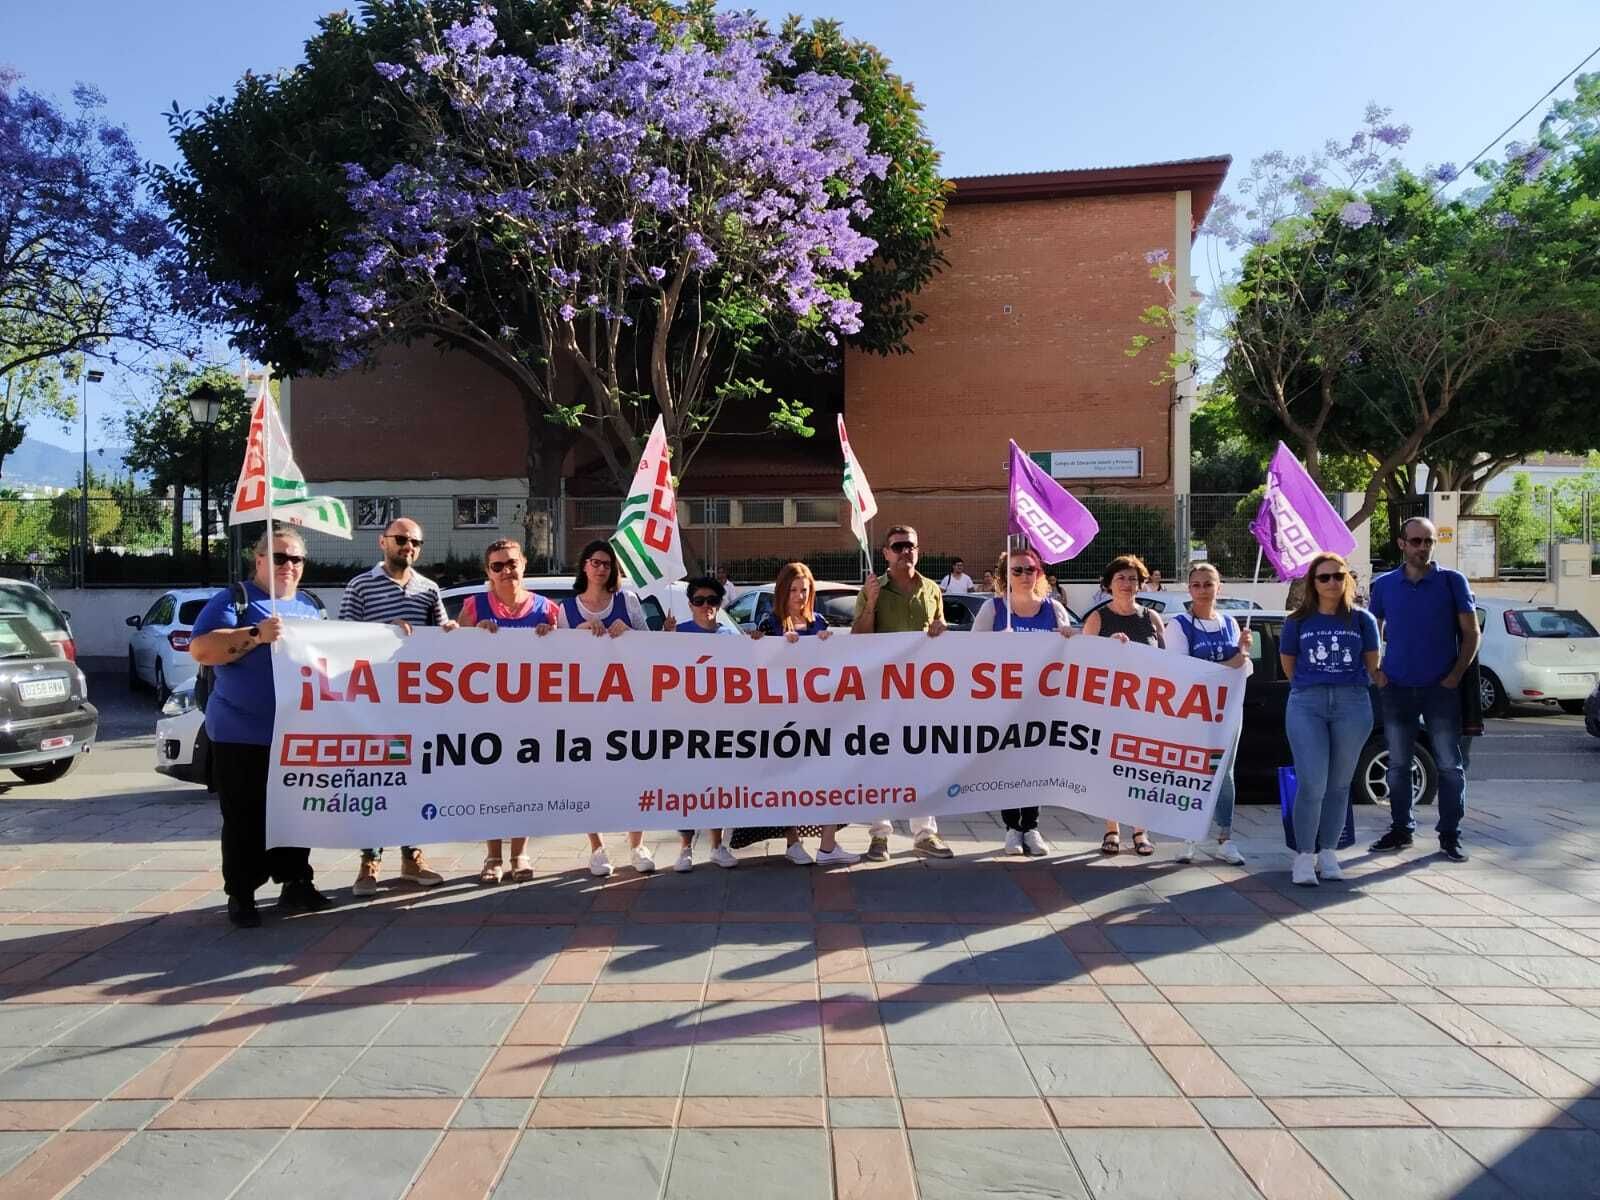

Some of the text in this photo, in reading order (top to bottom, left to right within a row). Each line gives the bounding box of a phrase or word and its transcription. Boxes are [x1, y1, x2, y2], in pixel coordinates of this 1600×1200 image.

[1017, 496, 1067, 550] CCOO
[300, 655, 1228, 723] ¡LA ESCUELA PÚBLICA NO SE CIERRA!
[284, 736, 387, 764] CCOO
[421, 719, 1102, 775] ¡NO a la SUPRESIÓN de UNIDADES!
[1111, 735, 1208, 772] CCOO
[282, 768, 408, 789] enseñanza
[1112, 763, 1213, 792] enseñanz
[302, 793, 388, 817] málaga
[439, 799, 591, 817] CCOO Enseñanza Málaga
[639, 786, 916, 815] #lapúblicanosecierra
[1127, 785, 1204, 812] málaga
